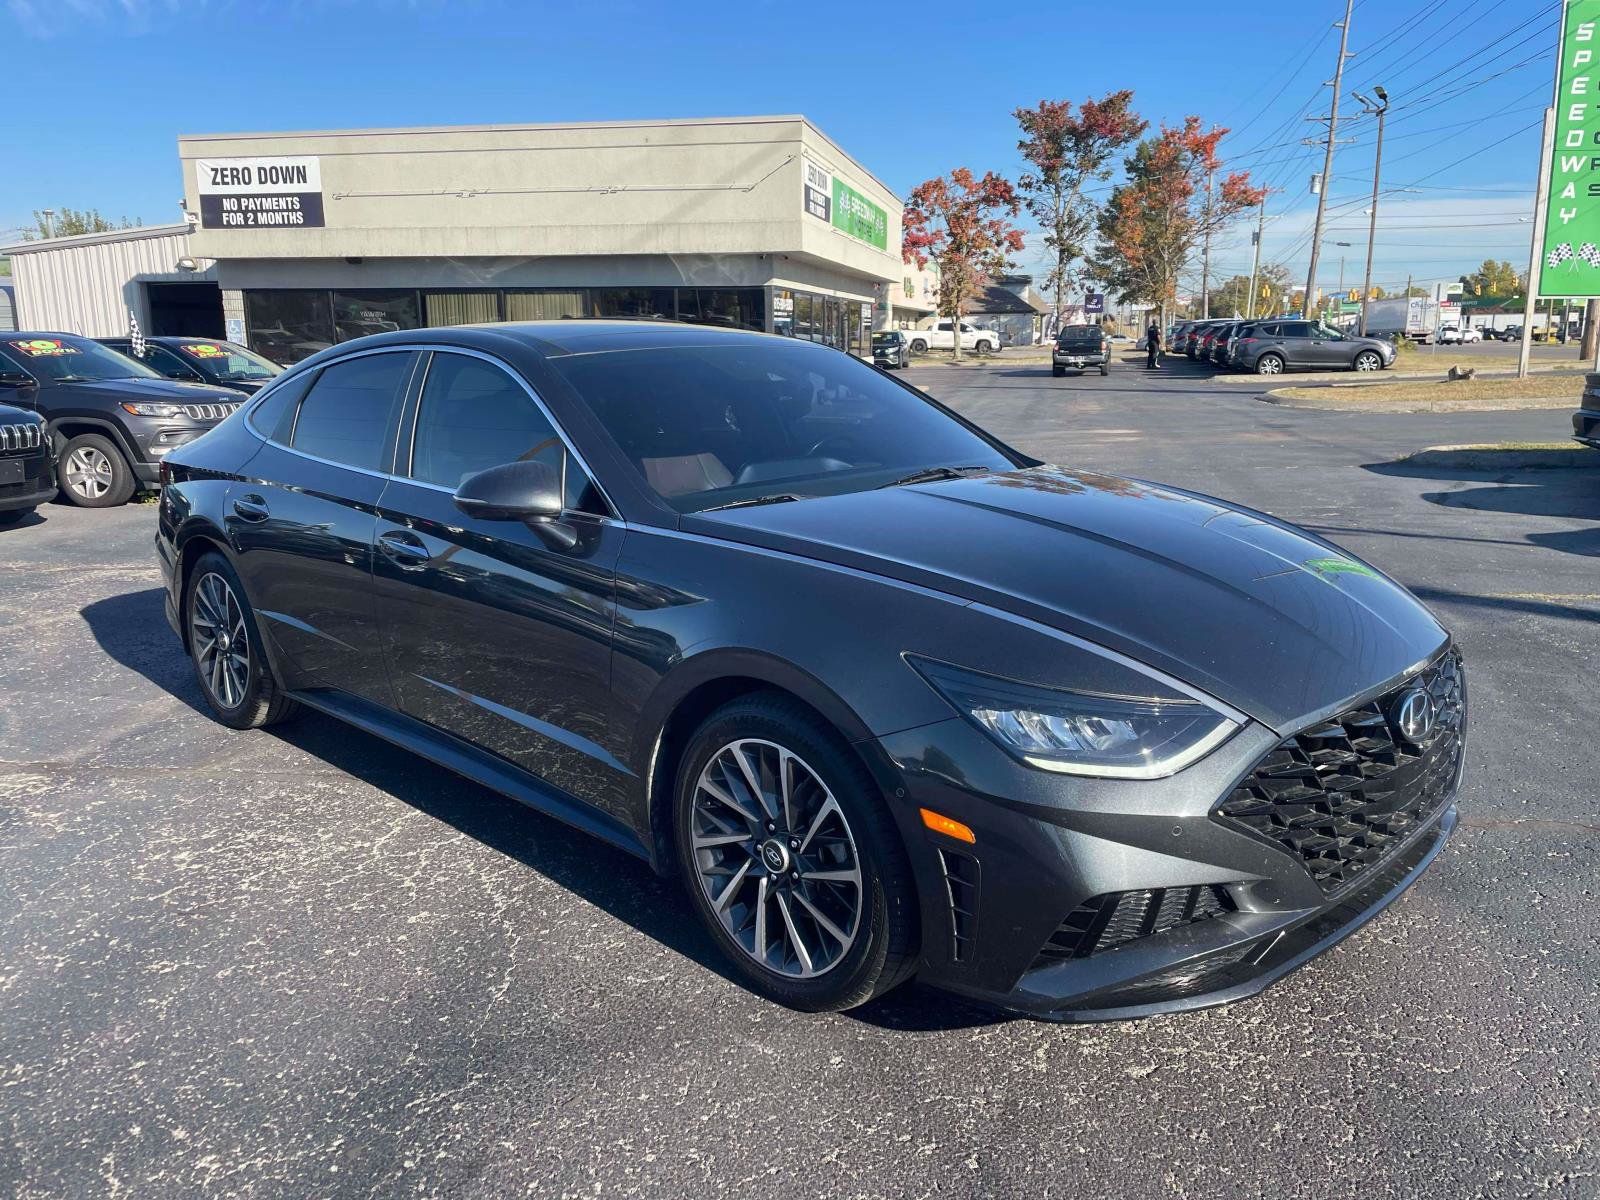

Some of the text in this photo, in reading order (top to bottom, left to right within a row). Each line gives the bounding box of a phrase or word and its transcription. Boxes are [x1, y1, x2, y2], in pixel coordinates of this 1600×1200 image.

[1560, 22, 1595, 225] SPEEDWAY
[210, 165, 308, 186] ZERO DOWN
[222, 196, 301, 211] NO PAYMENTS
[222, 211, 304, 225] FOR 2 MONTHS
[31, 347, 76, 356] DOWN
